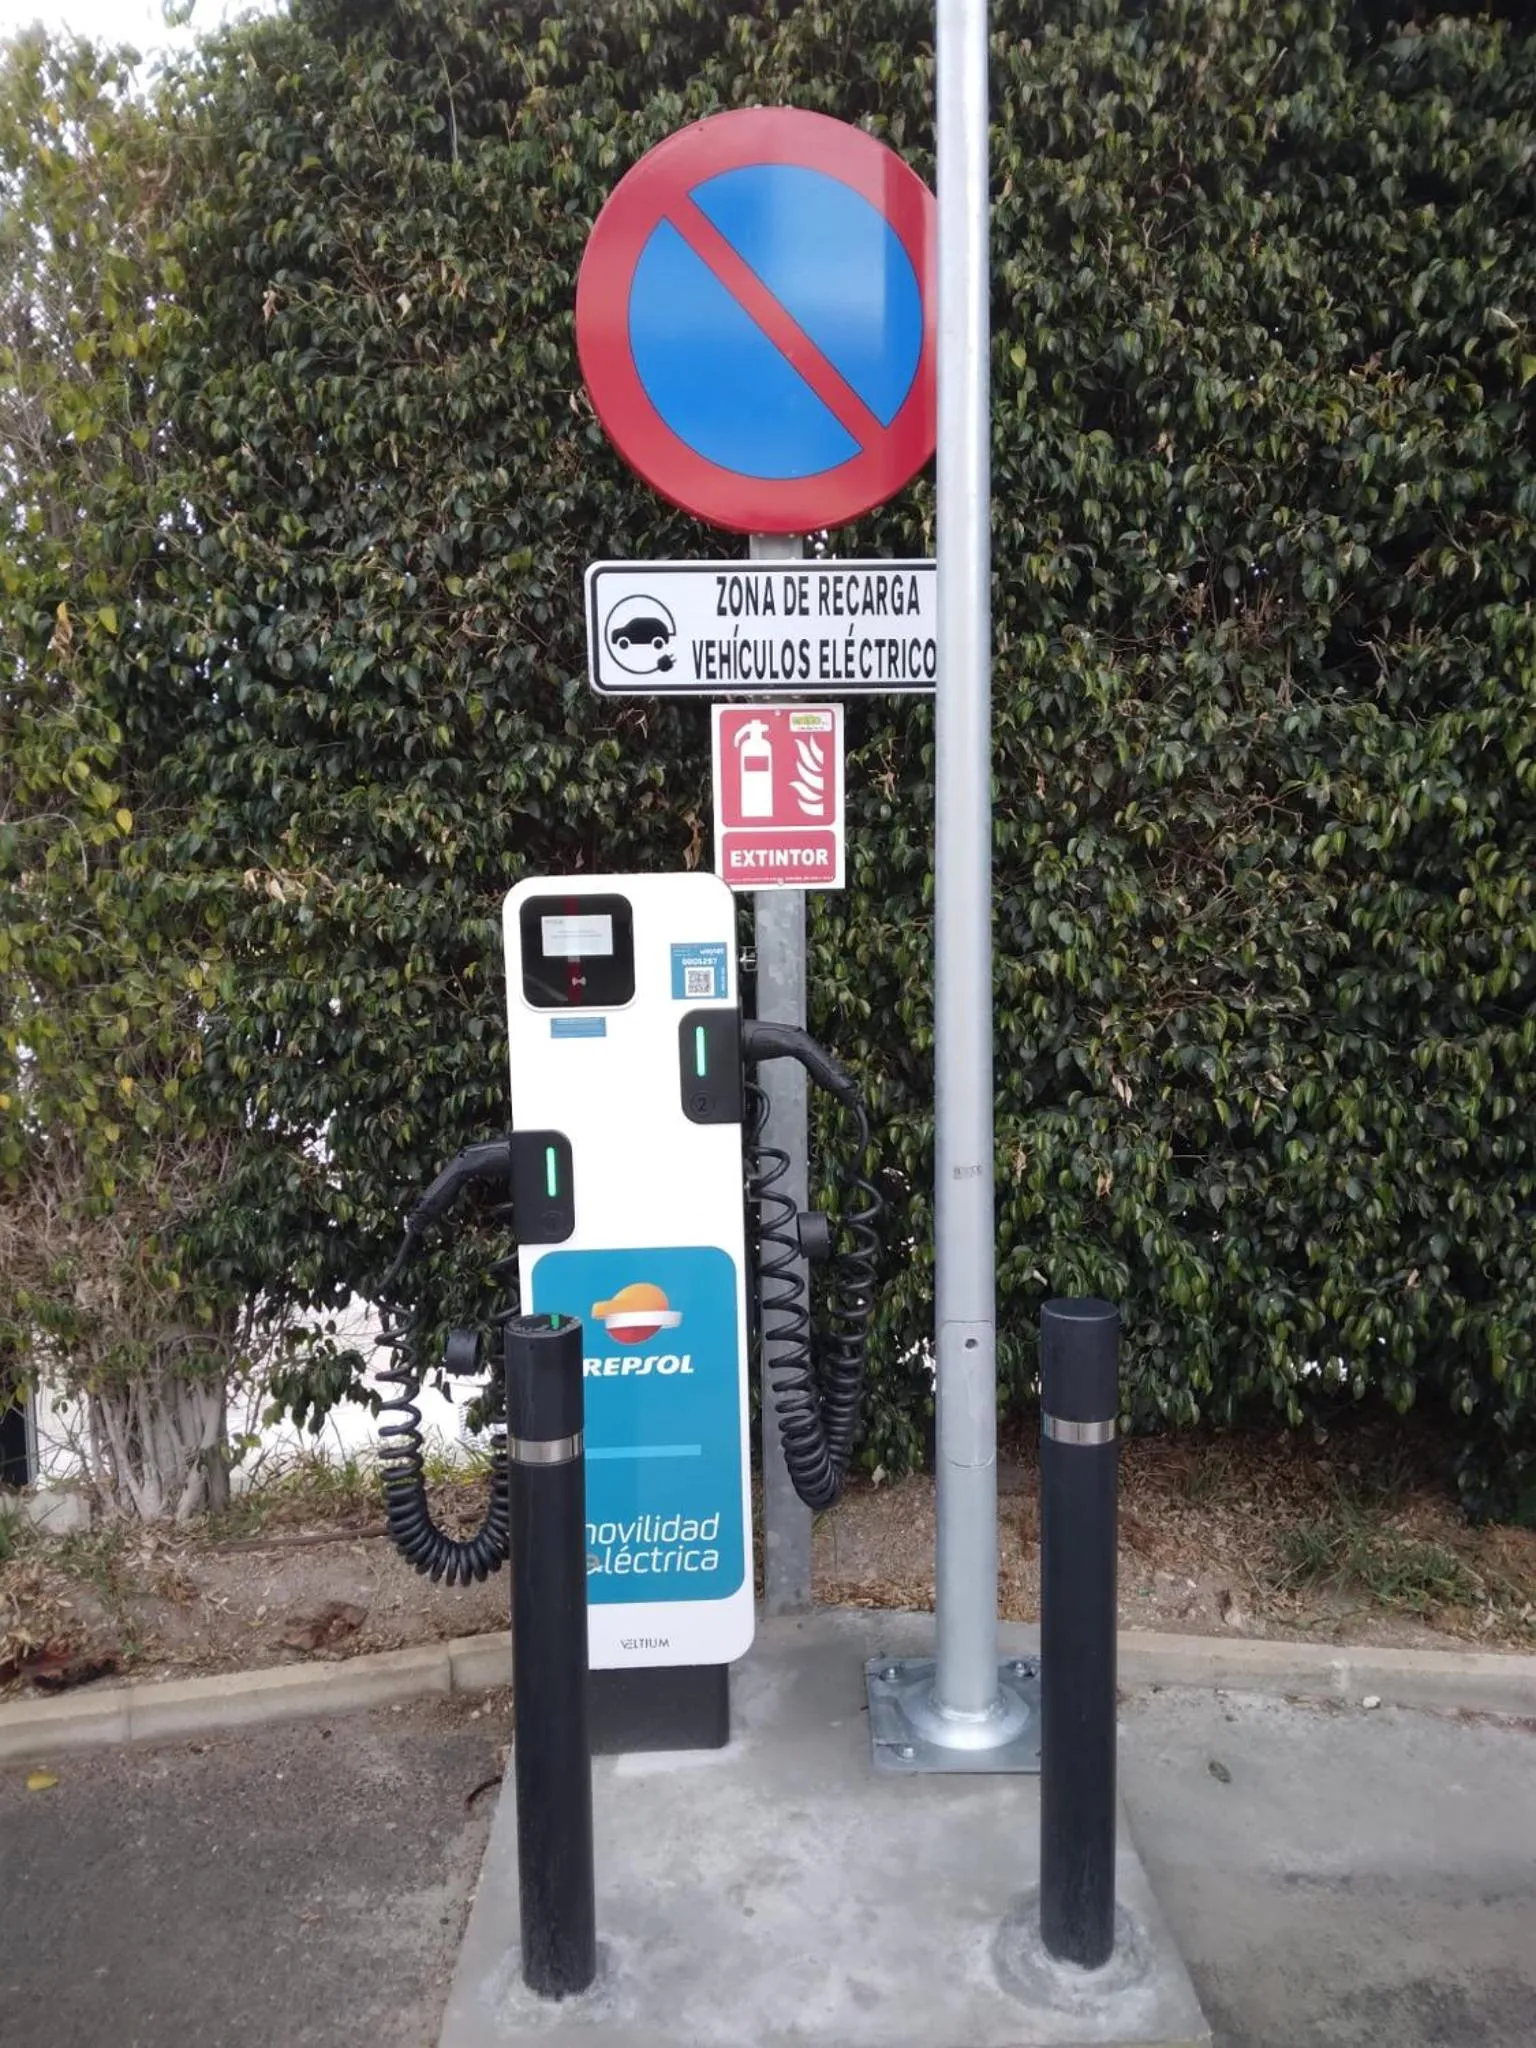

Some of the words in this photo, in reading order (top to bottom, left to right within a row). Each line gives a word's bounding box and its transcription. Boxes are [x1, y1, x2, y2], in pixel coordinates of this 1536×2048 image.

[716, 576, 775, 616] ZONA
[784, 576, 809, 615] DE
[819, 575, 920, 615] RECARGA
[692, 624, 810, 679] VEHÍCULOS
[819, 623, 936, 678] ELÉCTRICO
[730, 849, 828, 867] EXTINTOR
[583, 1355, 694, 1377] REPSOL
[620, 1638, 669, 1649] VELTIUM
